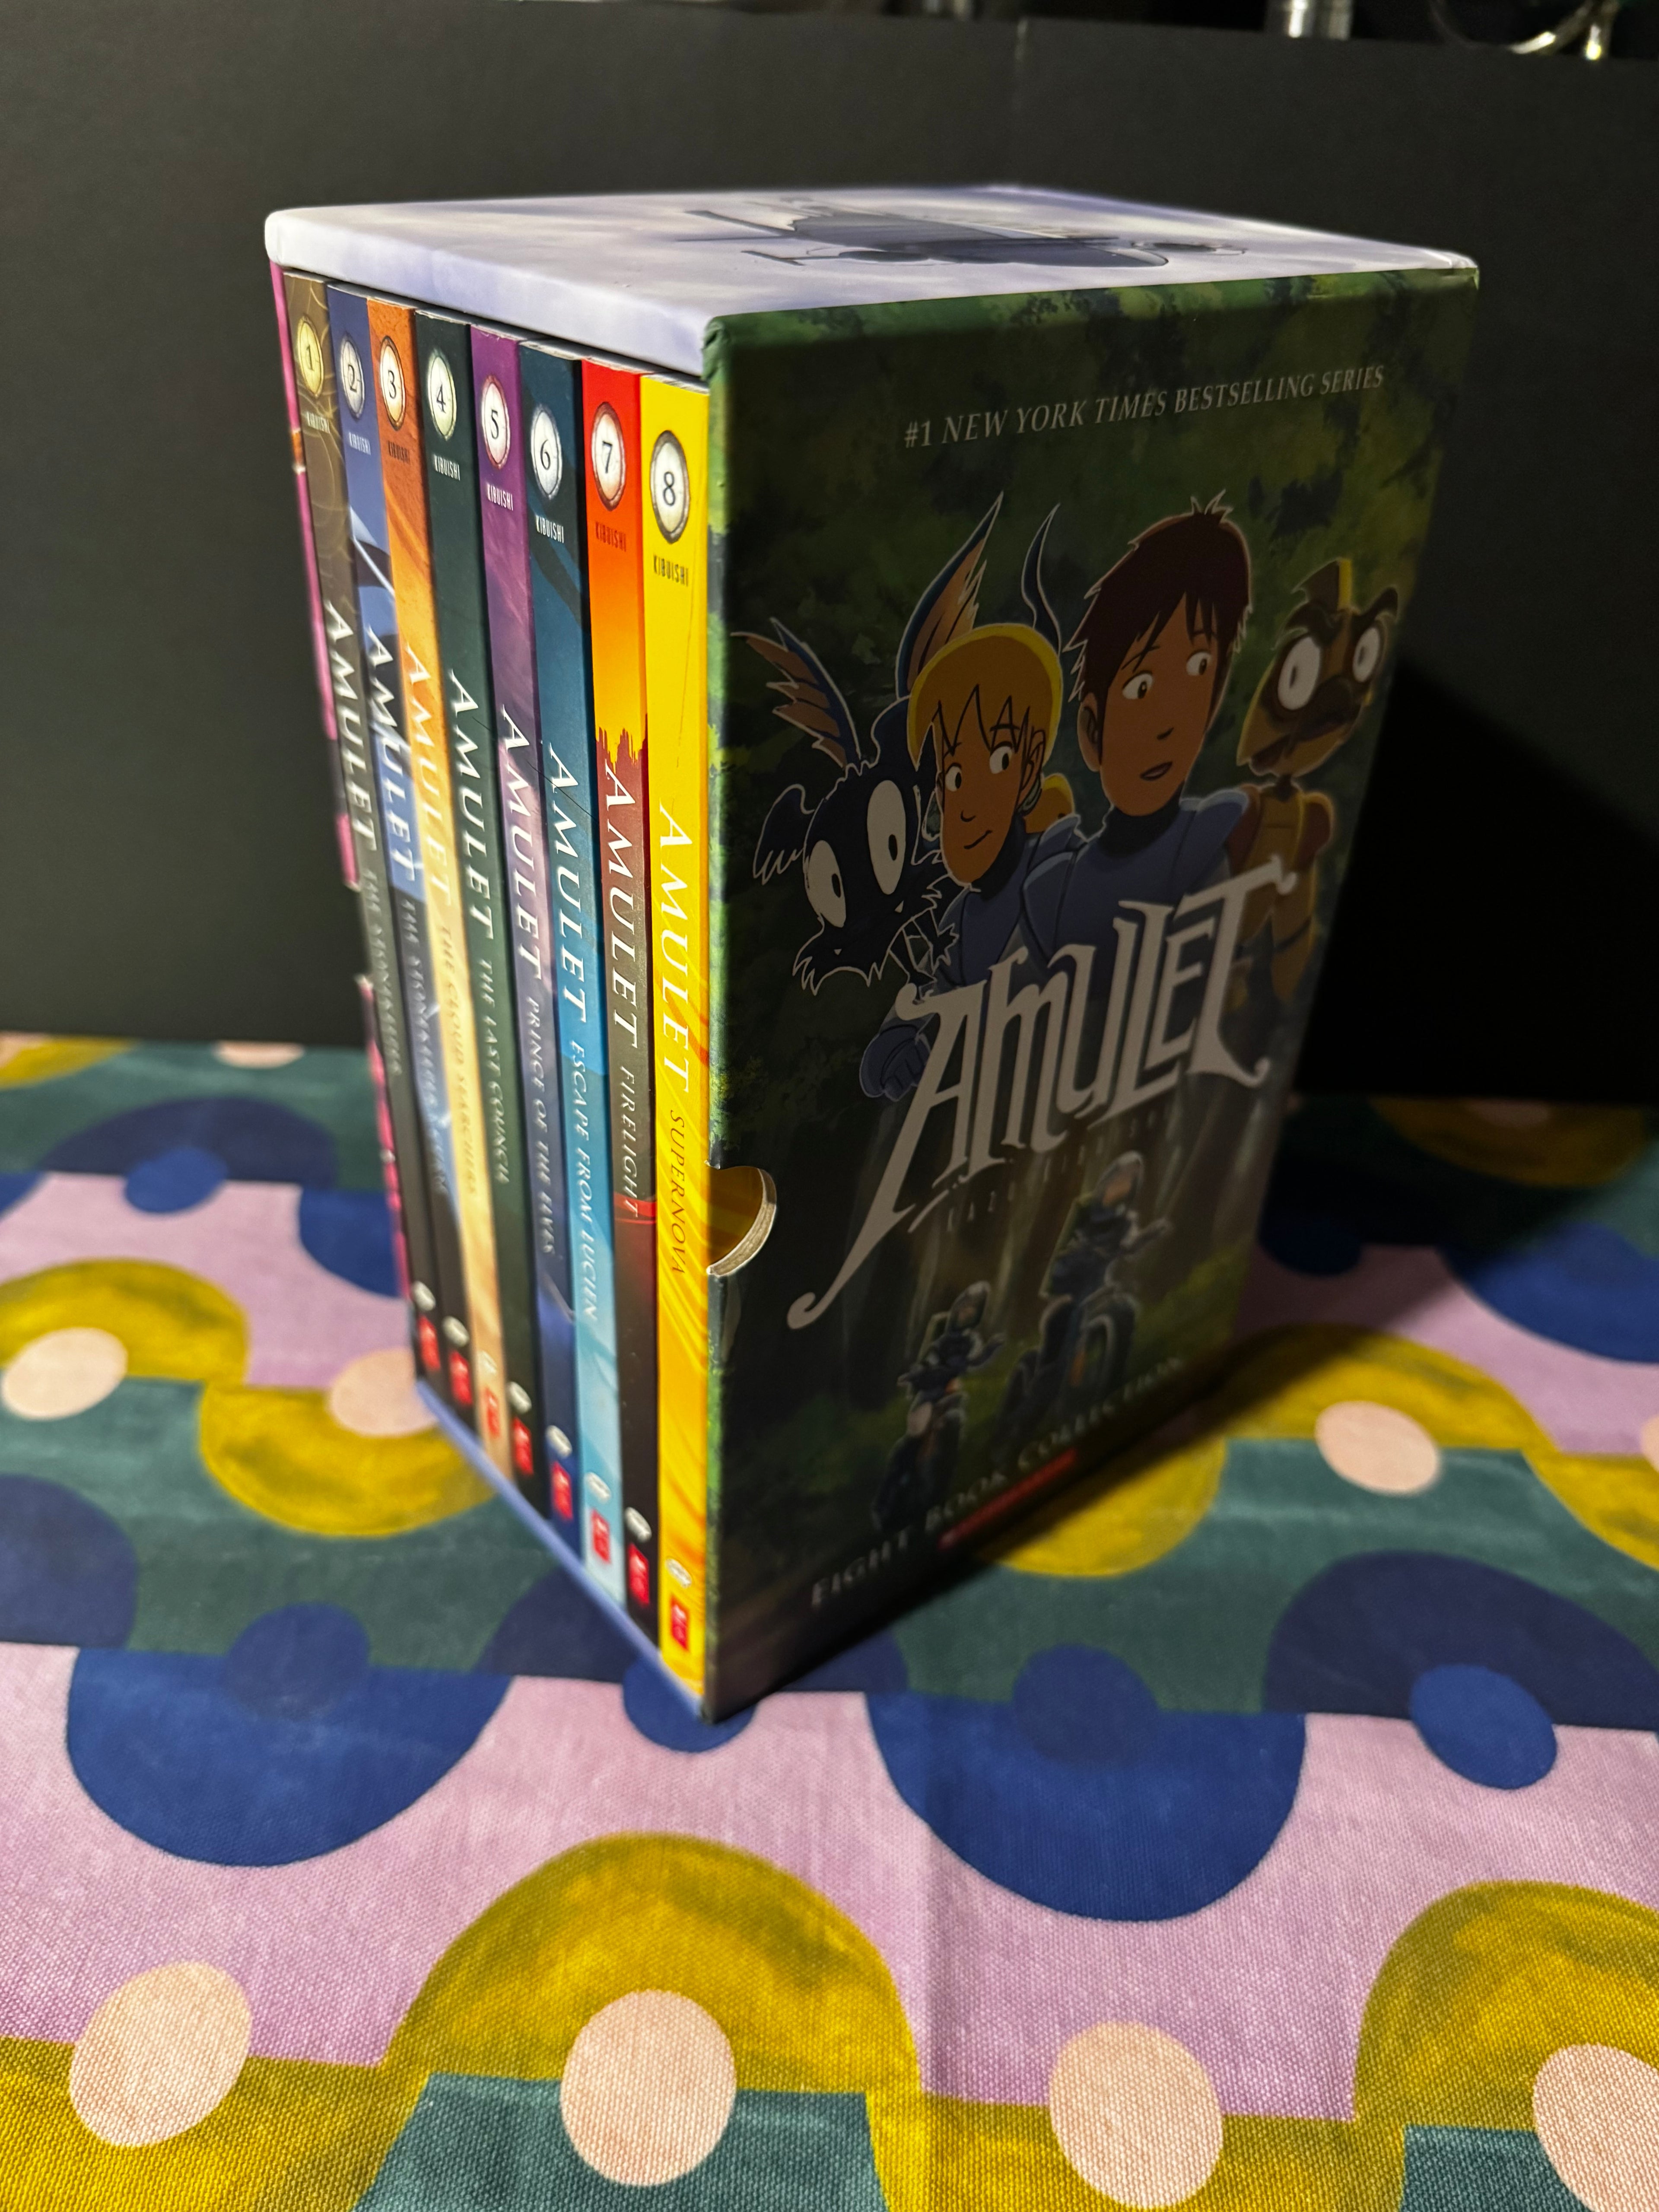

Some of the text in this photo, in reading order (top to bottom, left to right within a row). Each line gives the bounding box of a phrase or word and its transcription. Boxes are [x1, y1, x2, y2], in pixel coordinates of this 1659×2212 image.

[305, 345, 314, 372] 1
[348, 365, 357, 391] 2
[388, 370, 397, 400] 3
[436, 384, 446, 413] 4
[905, 364, 1384, 448] #1 NEW YORK TIMES BESTSELLING SERIES
[491, 410, 499, 439] 5
[434, 454, 461, 480] KIBUISHI
[540, 439, 551, 470] 6
[602, 441, 612, 474] 7
[487, 483, 513, 511] KIBUISHI
[663, 471, 675, 506] 8
[535, 515, 564, 543] KIBUISHI
[595, 521, 626, 552] KIBUISHI
[653, 554, 689, 587] KIBUISHI
[324, 600, 376, 850] AMULET
[367, 624, 415, 880] AMULET
[406, 642, 451, 906] AMULET
[437, 926, 455, 973] THE
[449, 669, 493, 940] AMULET
[502, 704, 541, 979] AMULET
[478, 959, 496, 1008] THE
[605, 759, 639, 1217] AMULET FIRELIGHT
[483, 1016, 501, 1076] LAST
[526, 997, 545, 1092] PRINCE
[549, 743, 598, 1321] AMULET ESCAPE FROM LUCIEN
[659, 798, 693, 1276] AMULET SUPERNOVA
[534, 1099, 548, 1136] OF
[535, 1140, 551, 1185] THE
